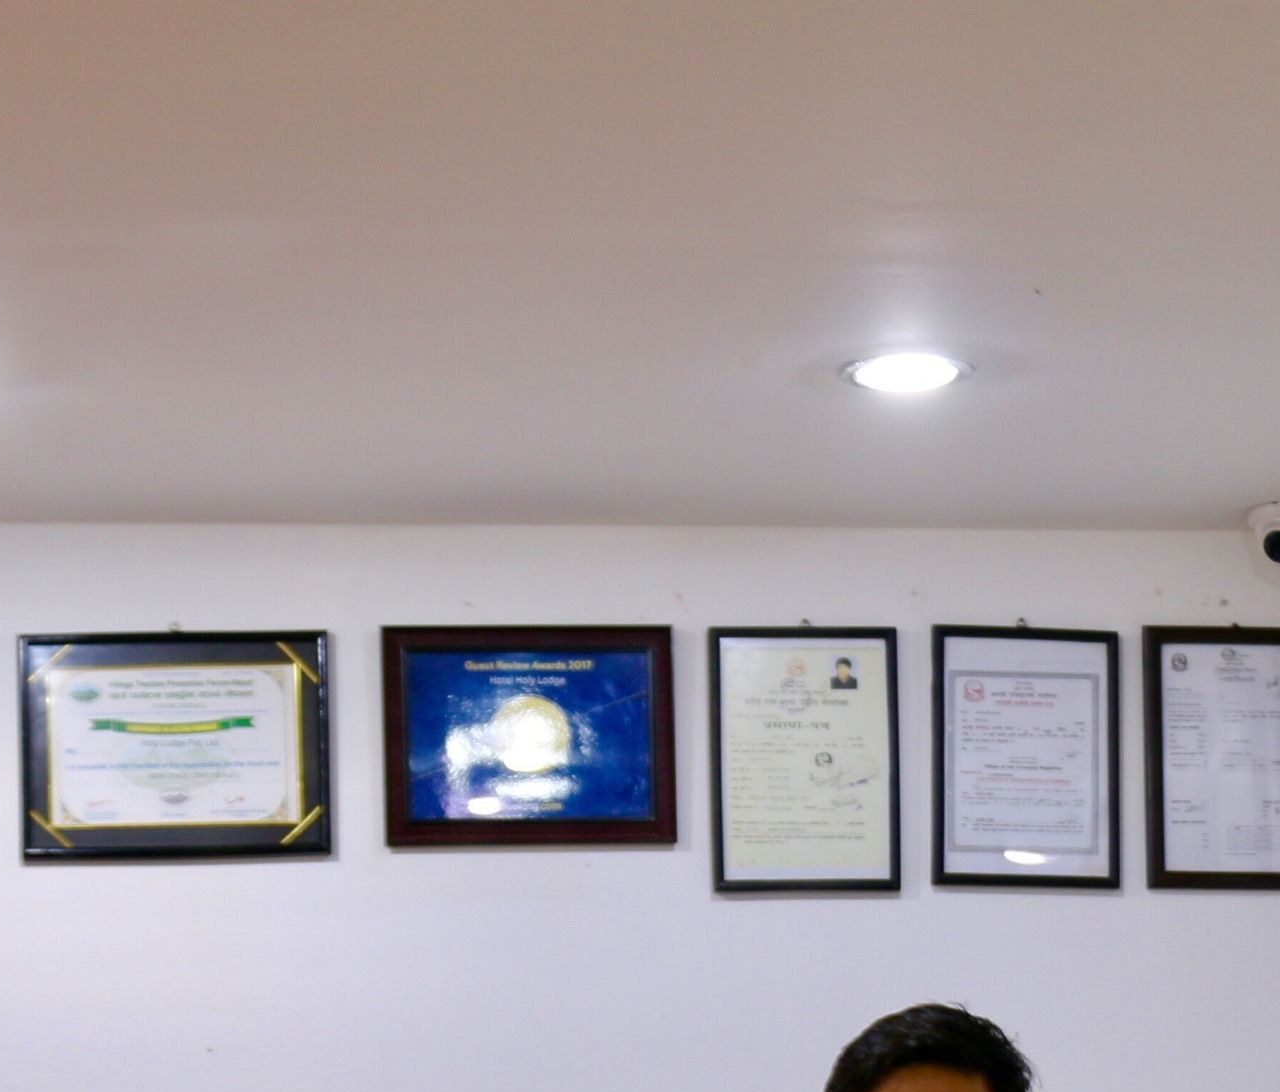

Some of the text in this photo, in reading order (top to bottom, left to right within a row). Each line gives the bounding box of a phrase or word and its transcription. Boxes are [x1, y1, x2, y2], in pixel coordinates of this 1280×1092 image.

[464, 660, 593, 670] Guest Review Awards 2017
[516, 676, 536, 687] Holy
[537, 676, 566, 686] Lodge
